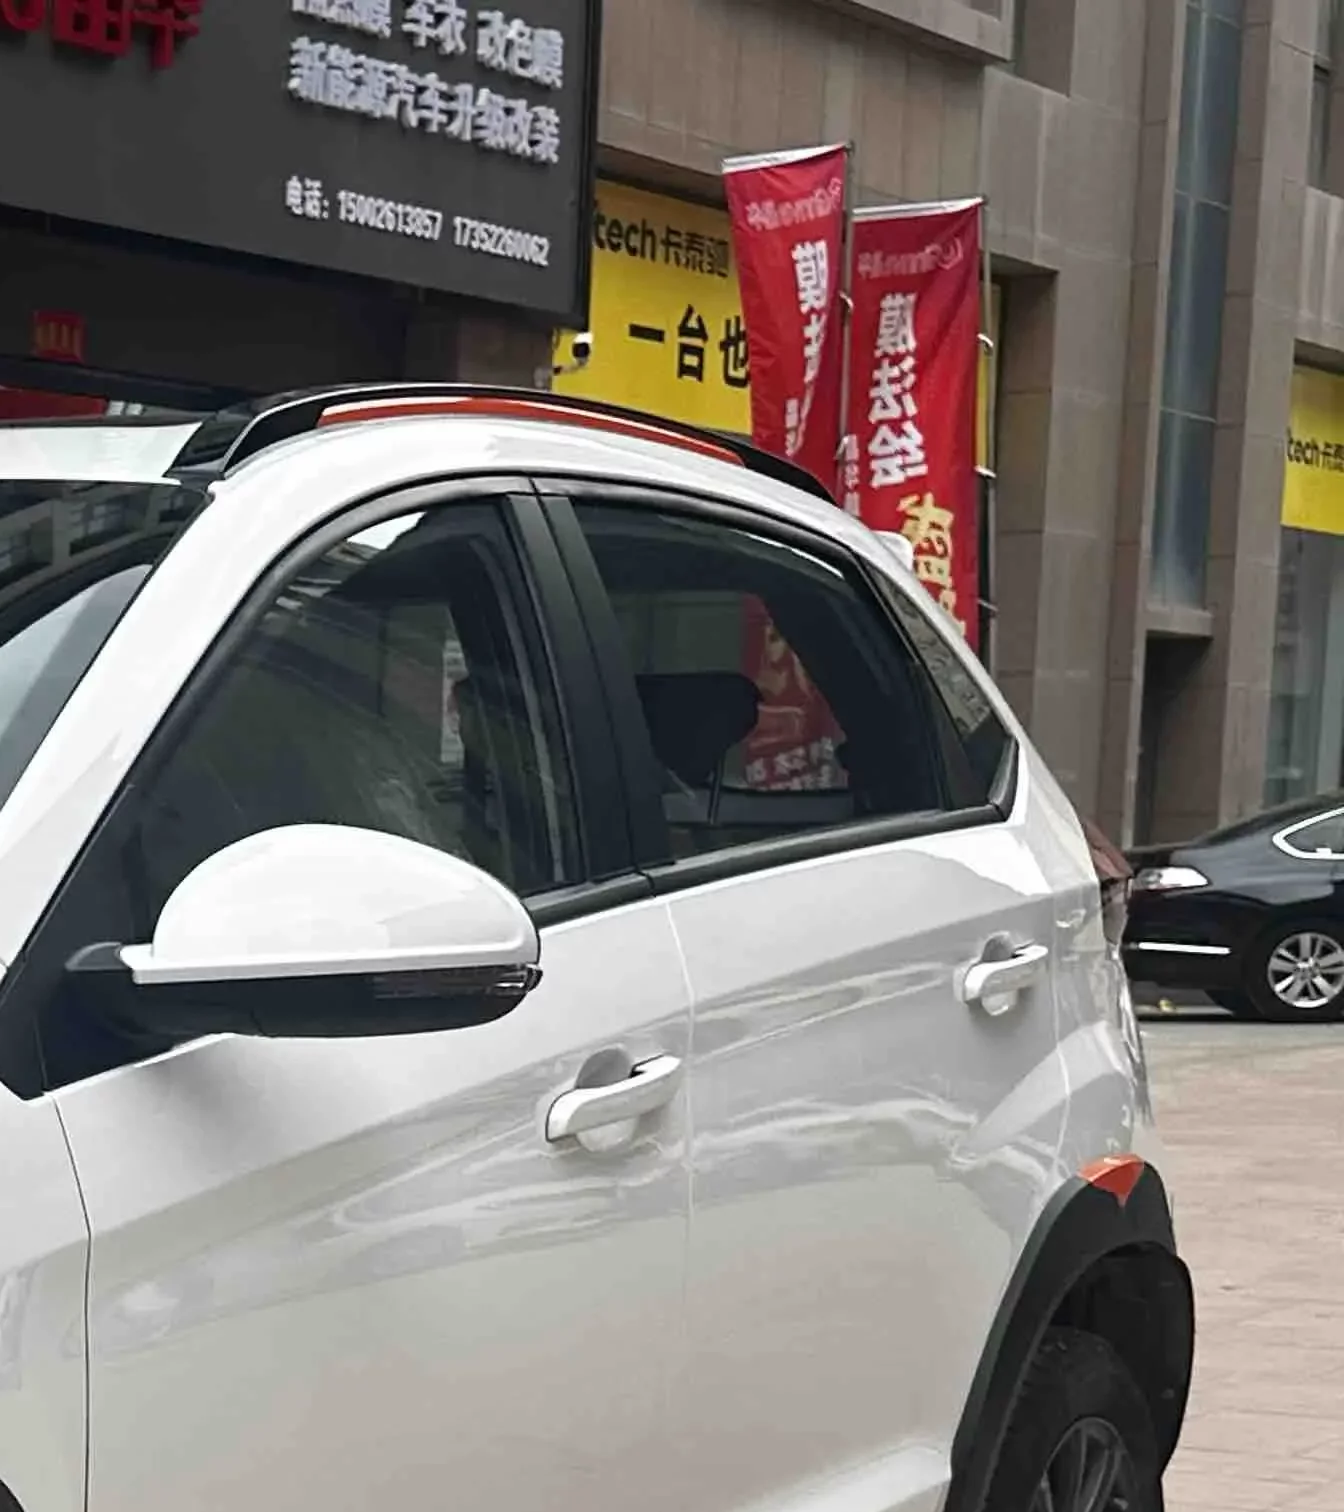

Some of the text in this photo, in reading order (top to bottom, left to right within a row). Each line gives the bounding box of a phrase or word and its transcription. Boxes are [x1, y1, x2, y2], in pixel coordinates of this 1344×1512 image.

[288, 36, 560, 163] 新能源汽车升级改装
[477, 10, 563, 88] 改色膜
